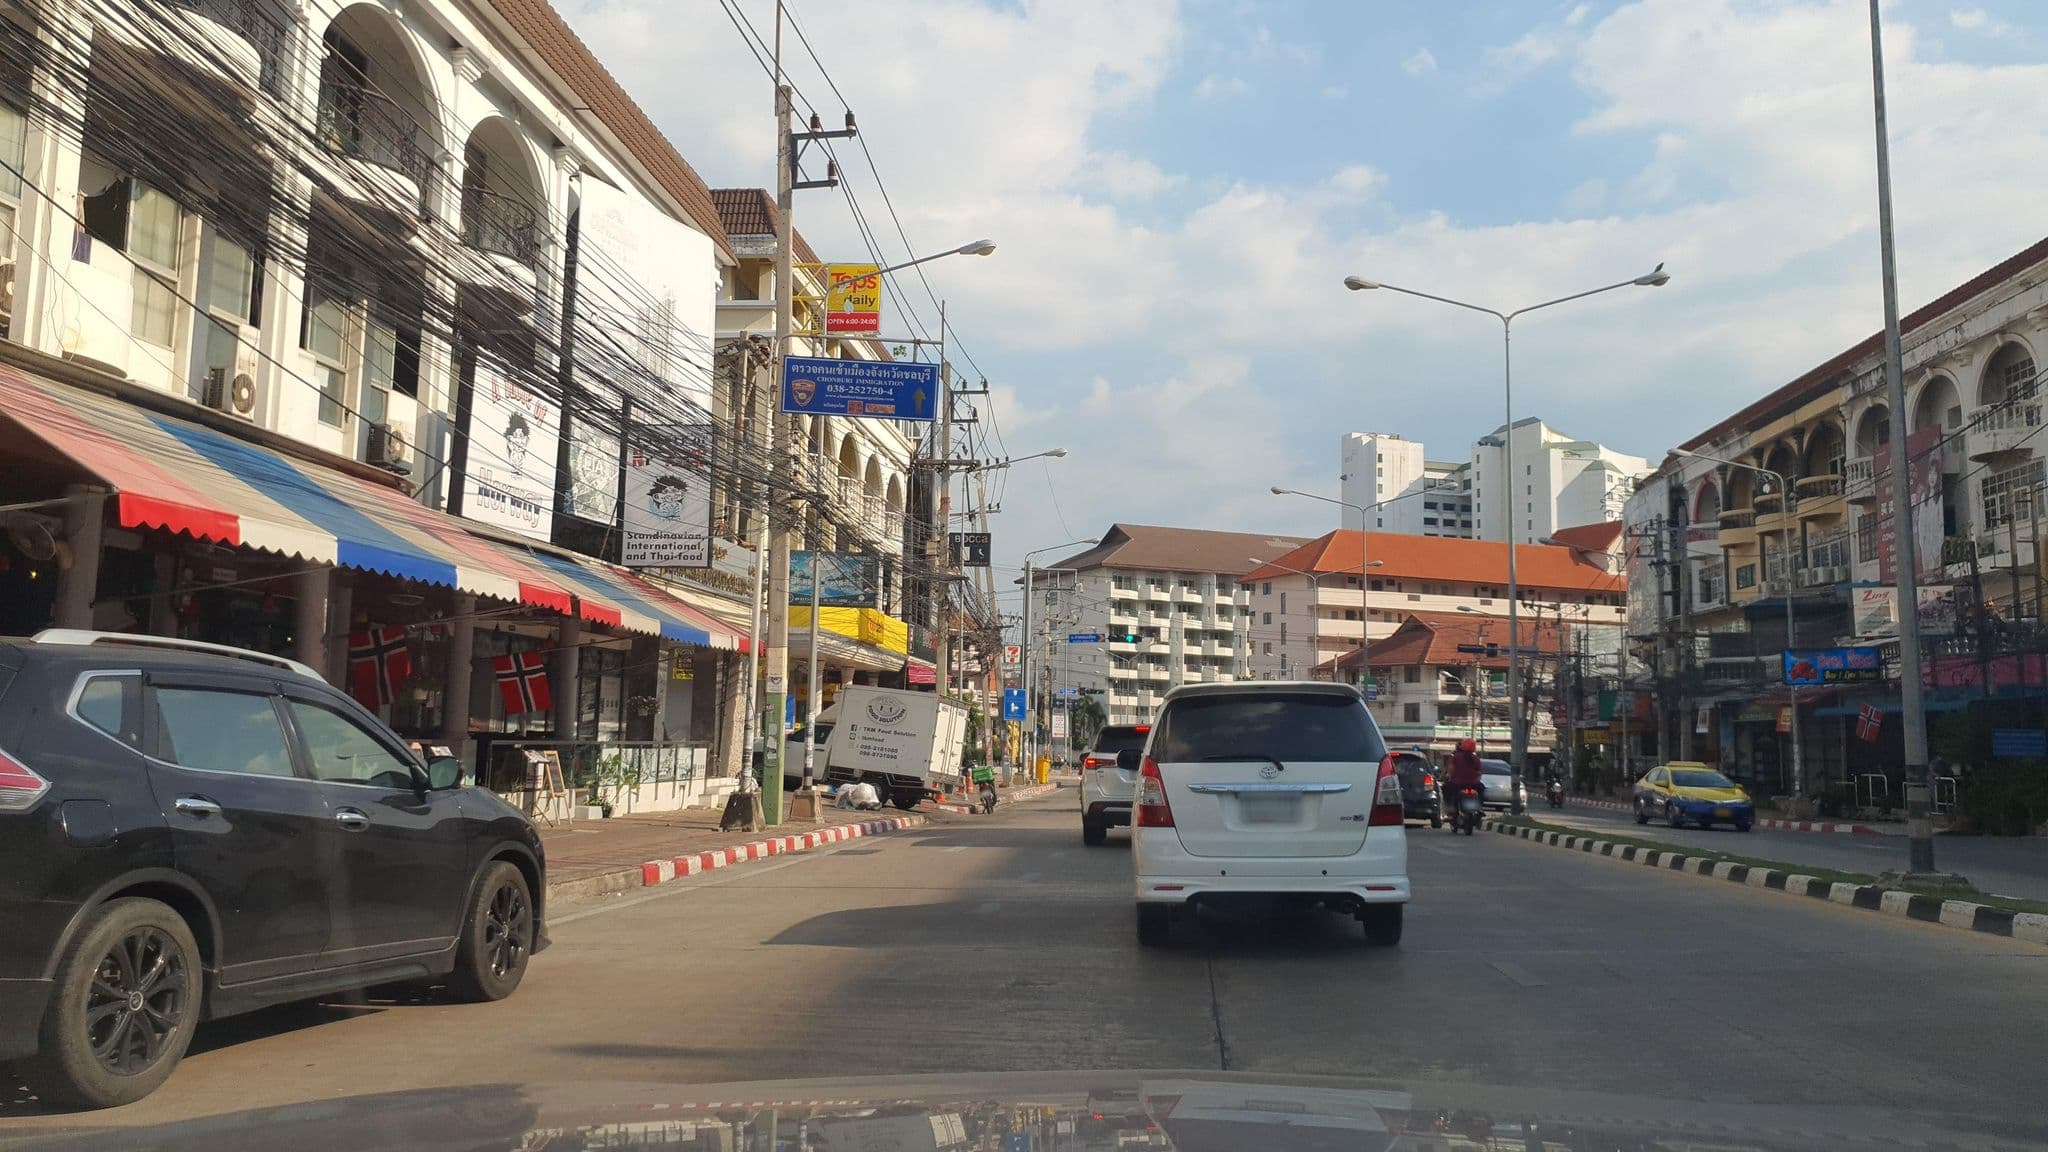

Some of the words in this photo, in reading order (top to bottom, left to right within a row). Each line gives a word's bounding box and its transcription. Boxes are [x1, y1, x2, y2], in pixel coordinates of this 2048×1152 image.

[816, 376, 853, 384] CHONBURI
[855, 378, 905, 387] IMMIGRATION
[827, 384, 893, 396] 038-252750-4
[626, 541, 705, 551] International,
[626, 551, 646, 560] and
[650, 551, 703, 561] Thai-food
[1863, 589, 1890, 601] Zing
[879, 708, 906, 723] SOLUTION
